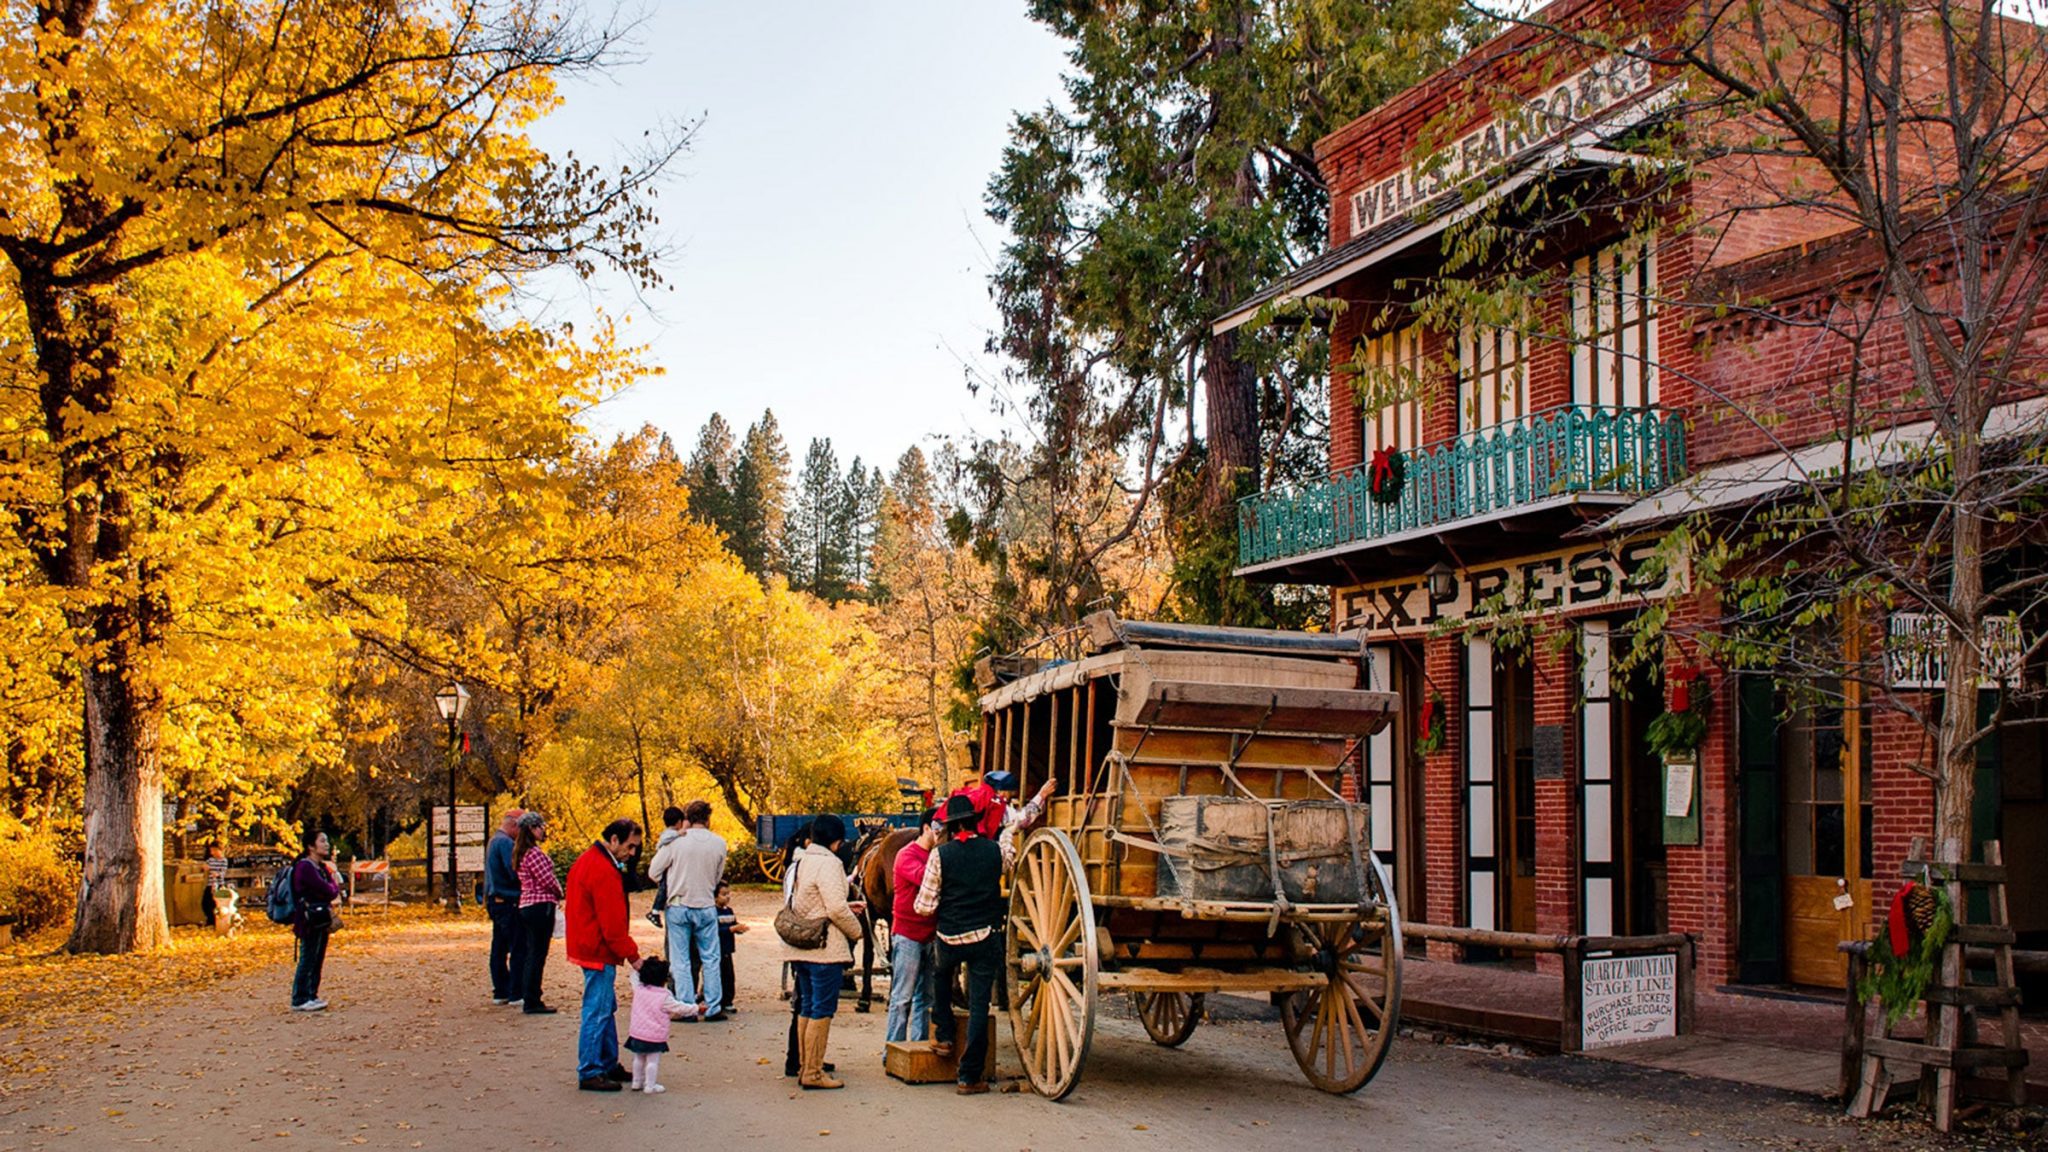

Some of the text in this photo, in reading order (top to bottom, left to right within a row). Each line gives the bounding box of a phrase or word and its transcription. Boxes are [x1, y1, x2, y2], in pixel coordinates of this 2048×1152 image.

[1341, 539, 1667, 632] EXPRESS
[1585, 958, 1674, 983] QUARTZ MOUNTAIN
[1586, 977, 1673, 996] STAGE LINE
[1585, 1004, 1673, 1037] INSIDE STAGECOACH
[1587, 993, 1671, 1022] PURCHASE TICKETS
